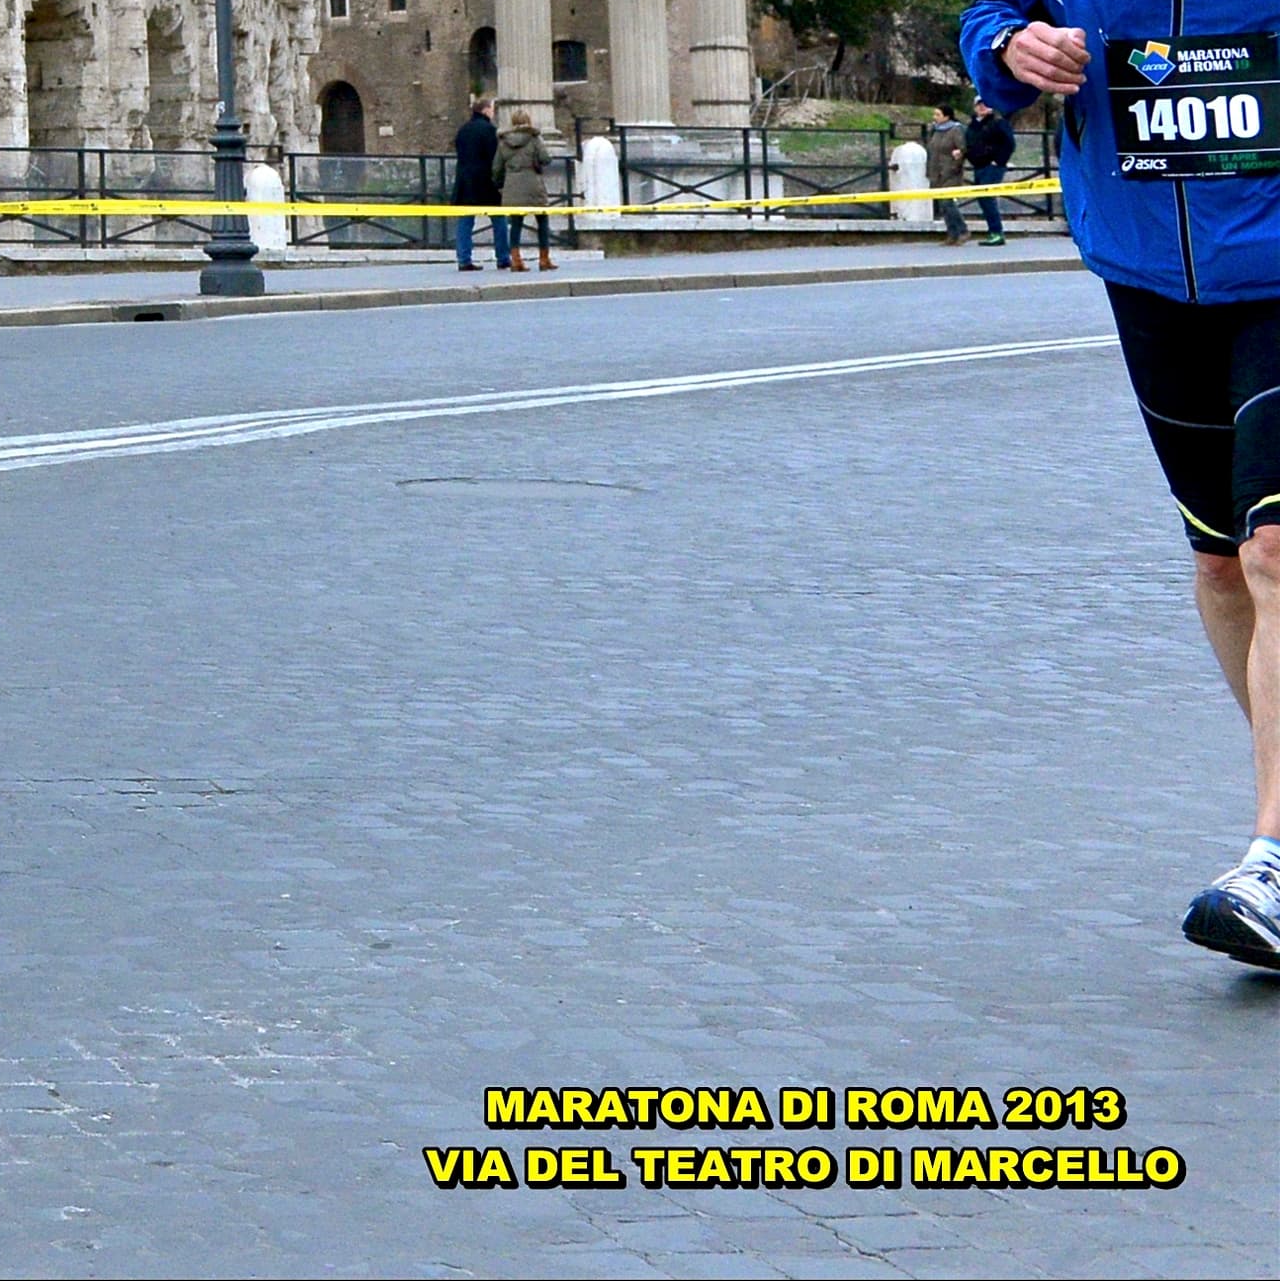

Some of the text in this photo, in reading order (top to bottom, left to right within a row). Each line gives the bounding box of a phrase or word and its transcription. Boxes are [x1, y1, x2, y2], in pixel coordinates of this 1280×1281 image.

[1177, 47, 1249, 61] MARATONA
[1178, 61, 1192, 73] di
[1193, 60, 1233, 72] ROMA
[1128, 94, 1260, 141] 14010
[1134, 158, 1167, 170] asics
